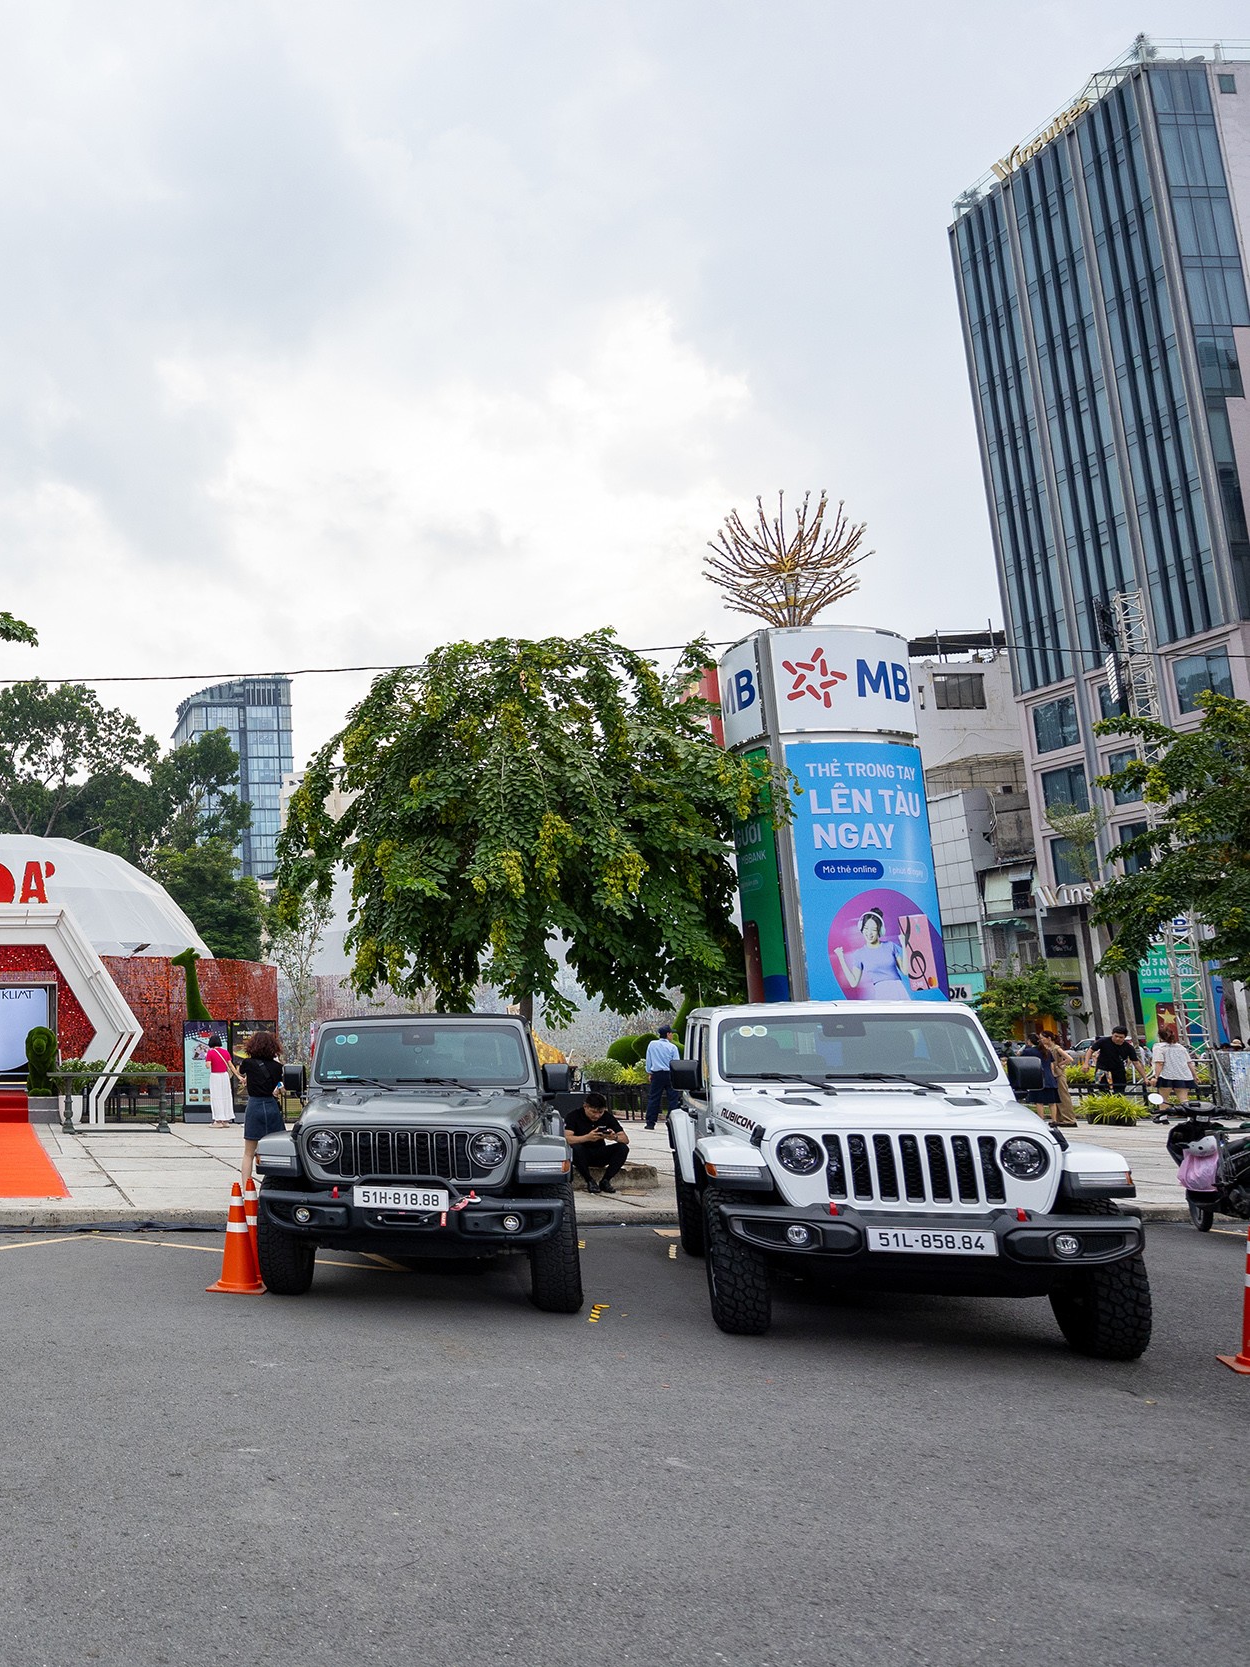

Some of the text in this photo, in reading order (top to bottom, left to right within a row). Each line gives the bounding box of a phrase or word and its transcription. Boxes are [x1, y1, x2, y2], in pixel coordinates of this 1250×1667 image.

[990, 97, 1090, 181] Winsuites
[856, 658, 911, 703] MB
[722, 669, 756, 721] MB
[805, 758, 916, 781] THẺ TRONG TAY
[809, 782, 921, 818] LÊN TÀU
[812, 822, 895, 850] NGAY
[822, 865, 835, 874] Mở
[837, 864, 851, 874] thẻ
[853, 865, 877, 874] online
[1036, 884, 1099, 907] Wins
[1, 990, 35, 1000] KLIMT
[721, 1107, 756, 1131] RUBICON
[362, 1190, 440, 1207] 51H-818.88
[878, 1232, 986, 1251] 51L-858.84
